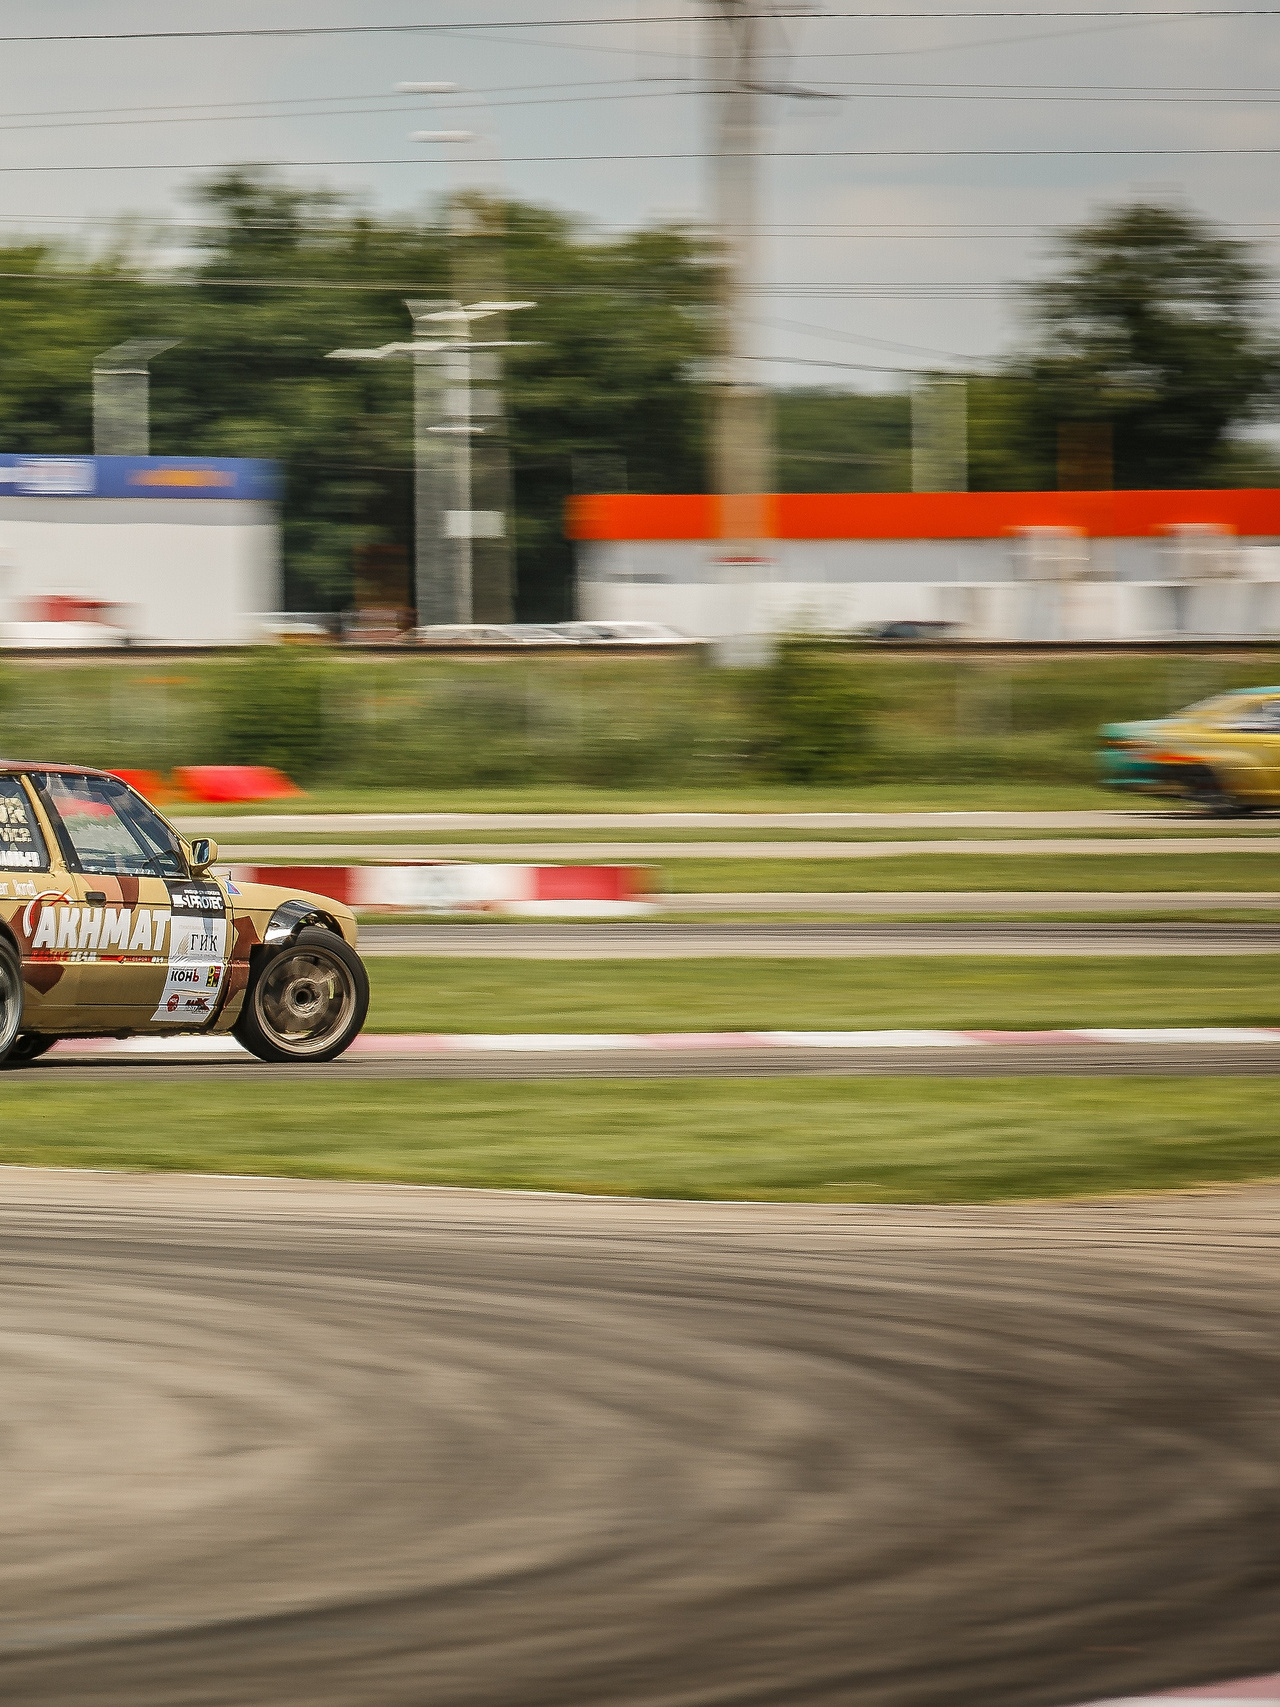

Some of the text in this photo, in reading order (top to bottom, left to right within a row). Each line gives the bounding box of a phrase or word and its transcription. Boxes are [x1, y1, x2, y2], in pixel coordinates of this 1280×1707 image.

[31, 906, 171, 951] AKHMAT
[191, 934, 218, 952] ГИК
[170, 968, 200, 982] КОНЬ
